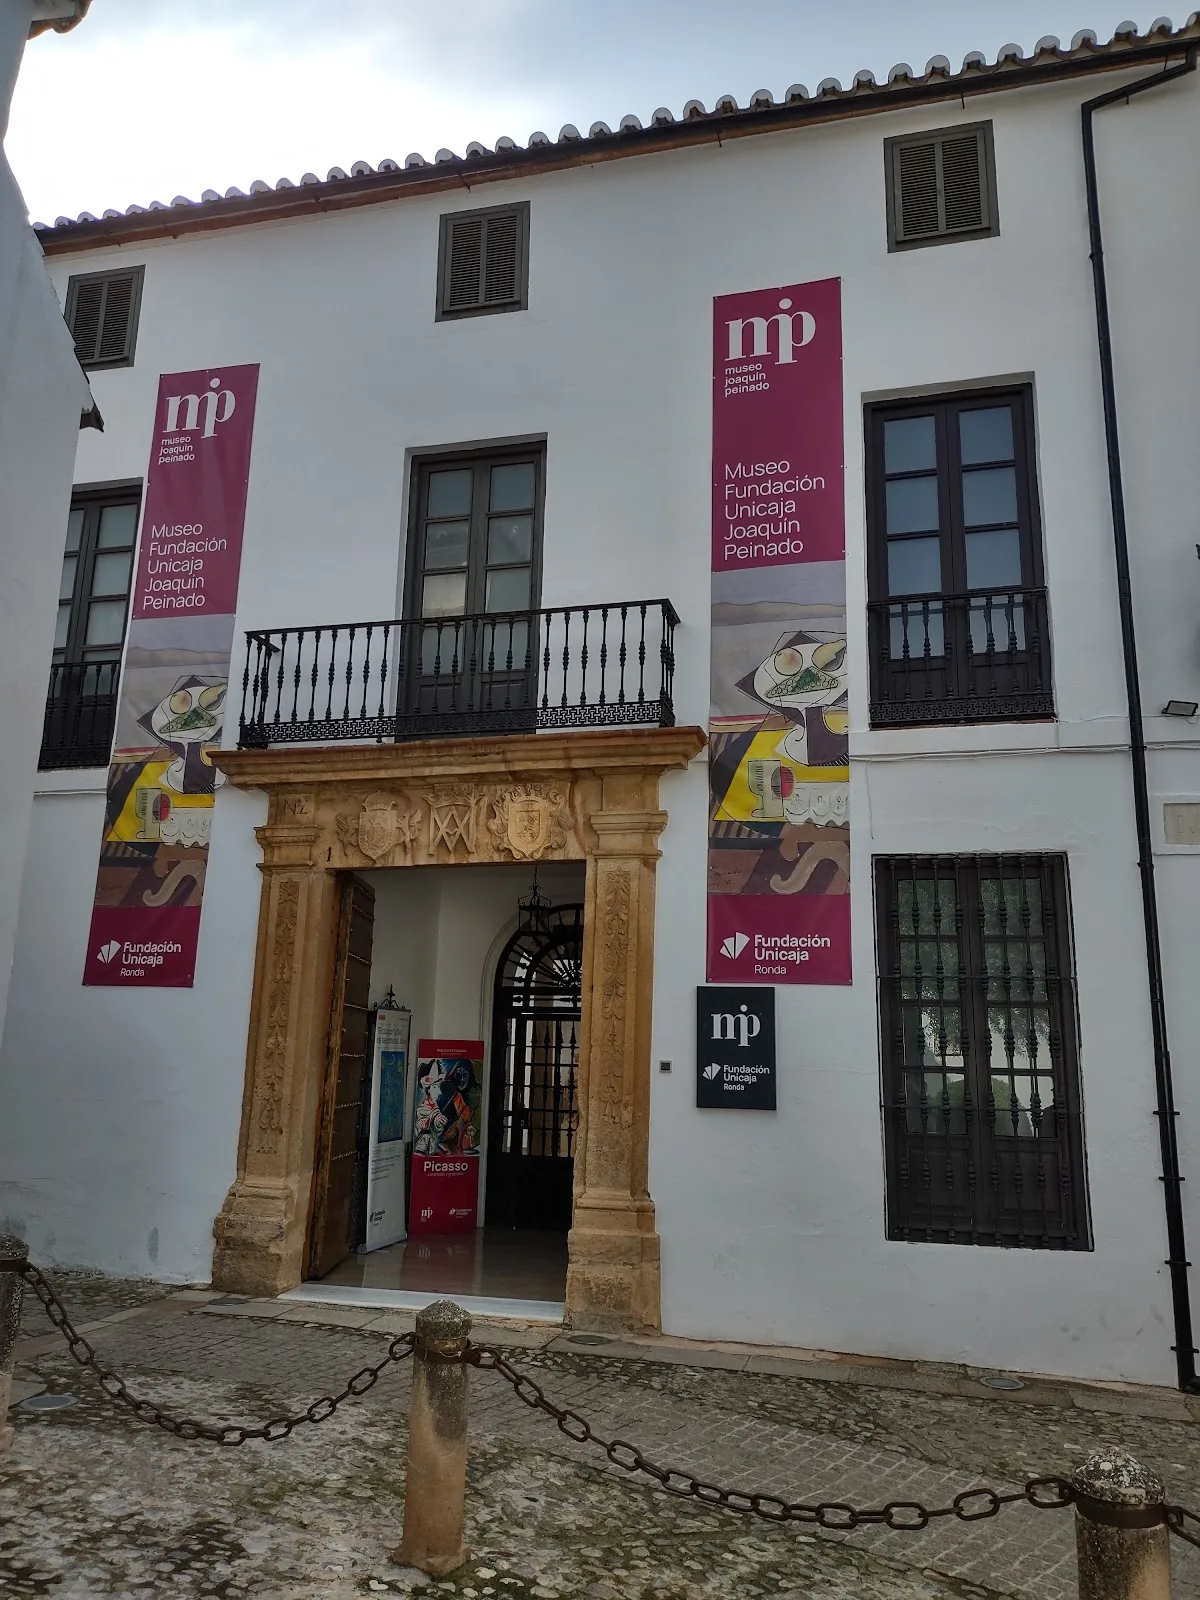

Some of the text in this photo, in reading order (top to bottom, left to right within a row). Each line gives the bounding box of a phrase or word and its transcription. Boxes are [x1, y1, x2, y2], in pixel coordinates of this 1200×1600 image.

[725, 363, 763, 375] museo
[725, 382, 770, 398] peinado
[161, 436, 191, 446] museo
[158, 453, 195, 465] peinado
[725, 459, 790, 480] Museo
[725, 474, 825, 500] Fundación
[725, 499, 796, 520] Unicaja
[152, 523, 203, 538] Museo
[724, 517, 800, 541] Joaquín
[149, 537, 227, 556] Fundación
[724, 538, 804, 560] Peinado
[148, 557, 203, 575] Unicaja
[144, 574, 205, 594] Joaquín
[143, 592, 205, 610] Peinado
[326, 846, 333, 862] 1
[123, 941, 181, 953] Fundación
[754, 934, 831, 948] Fundación
[122, 953, 163, 967] Unicaja
[754, 948, 809, 964] Unicaja
[120, 968, 144, 976] Ronda
[754, 965, 786, 974] Ronda
[723, 1064, 770, 1075] Fundación
[723, 1073, 757, 1084] Unicaja
[423, 1161, 469, 1172] Picasso
